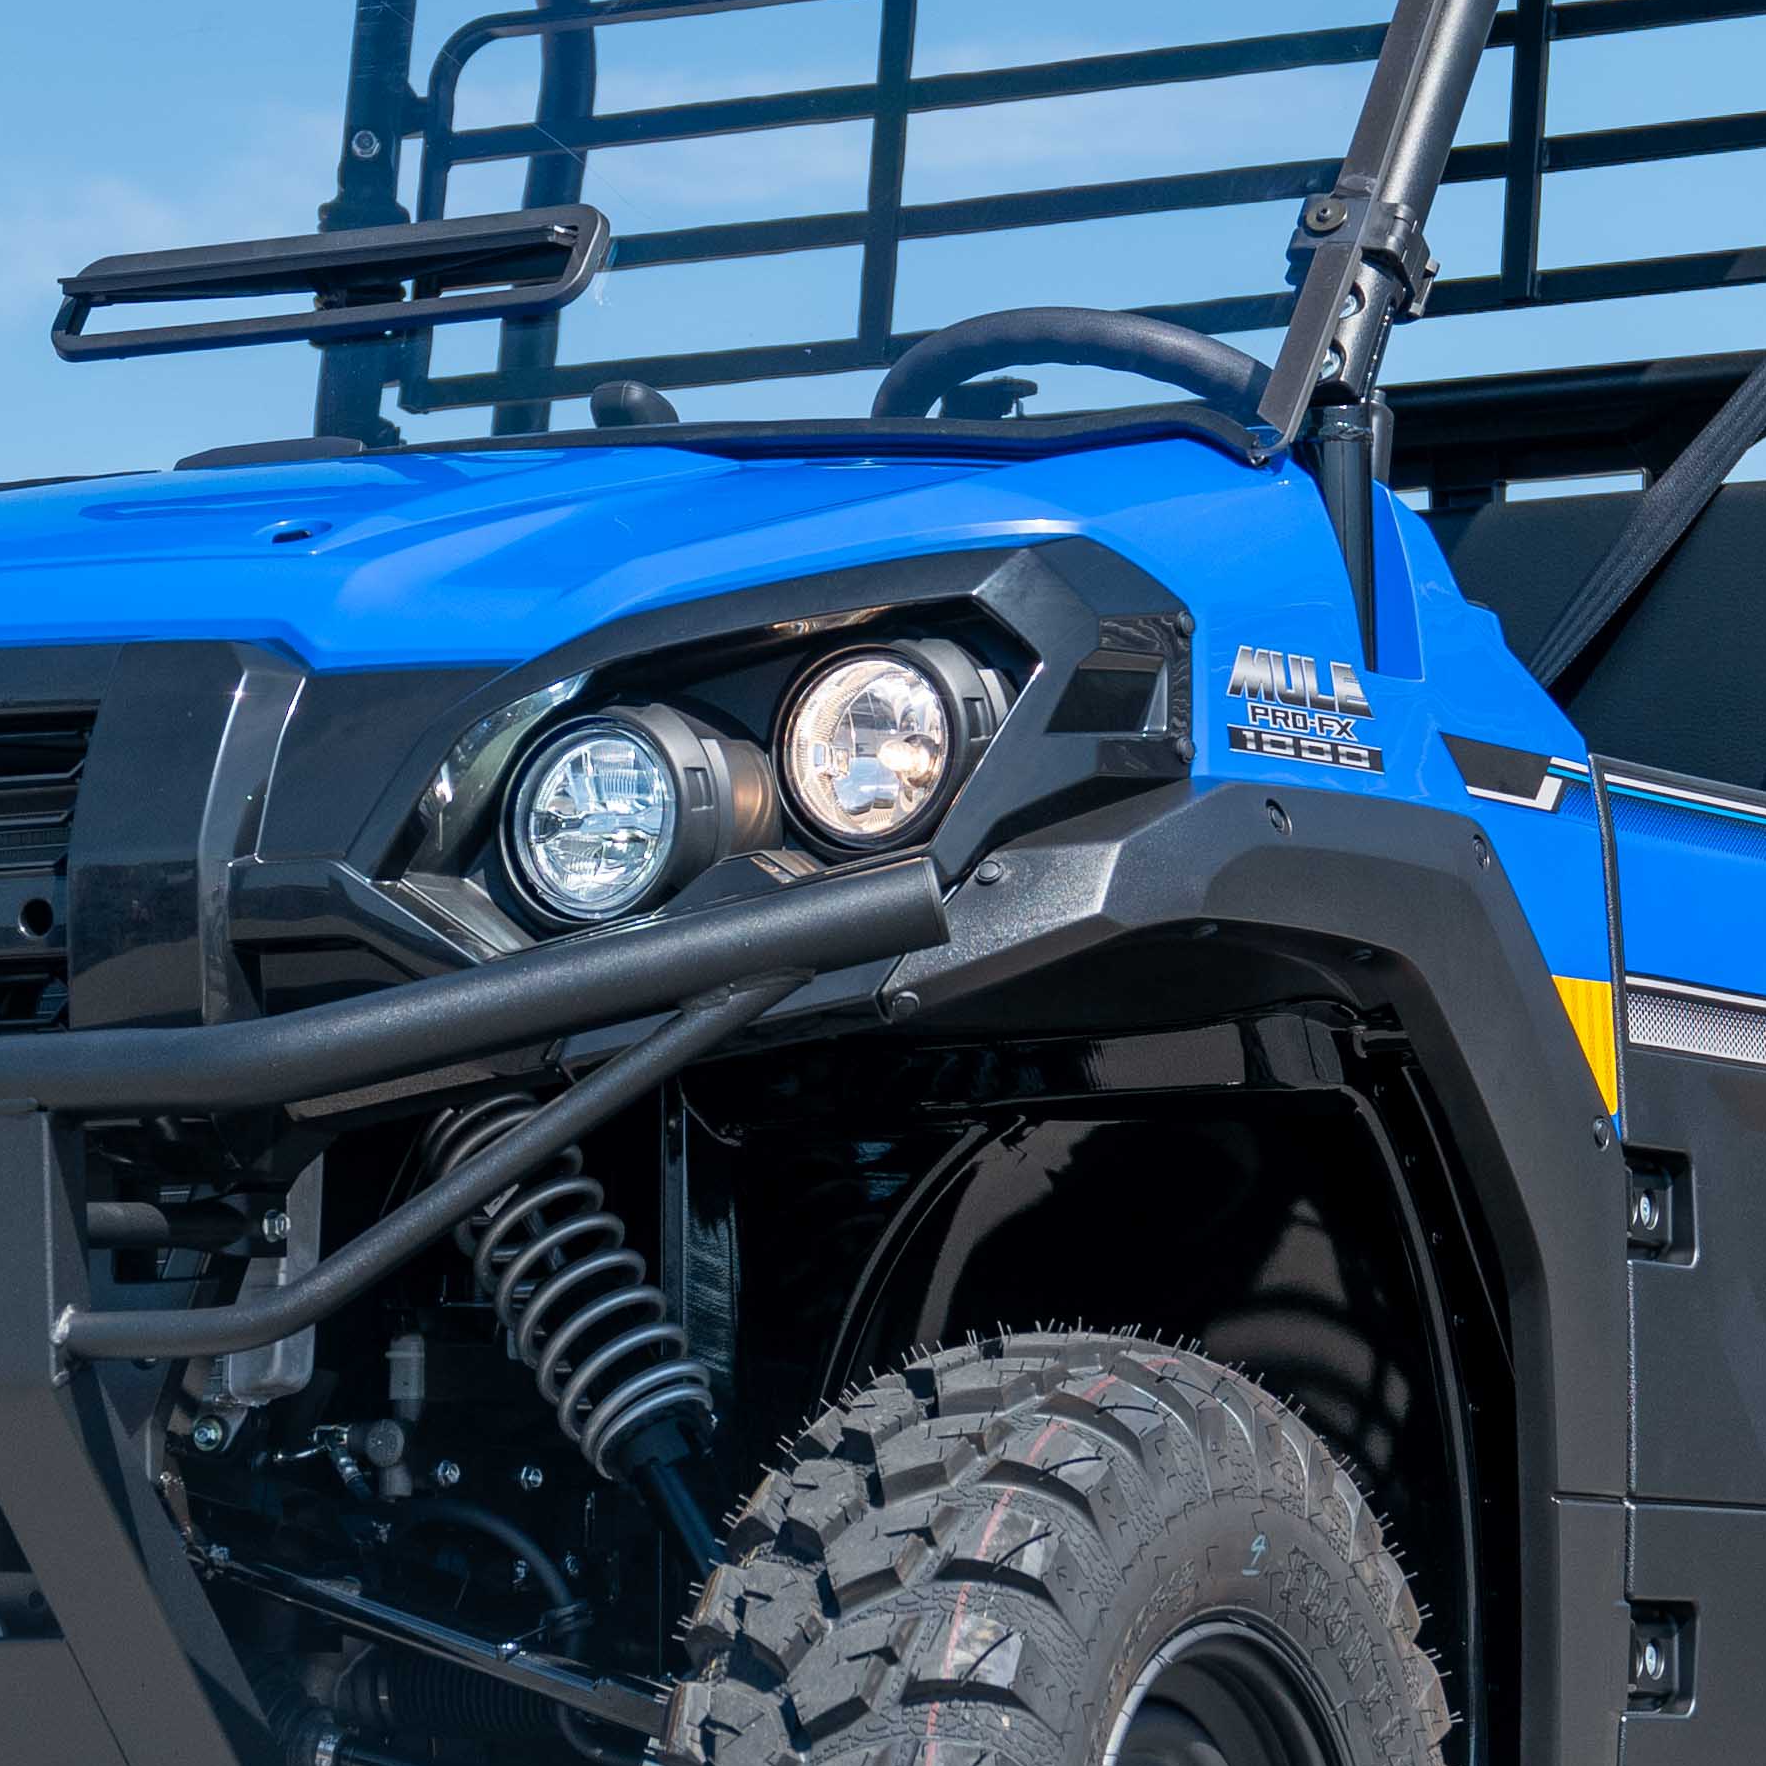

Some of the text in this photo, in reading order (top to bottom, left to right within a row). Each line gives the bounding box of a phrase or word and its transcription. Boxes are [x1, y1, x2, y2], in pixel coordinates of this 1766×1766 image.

[1226, 645, 1375, 721] MULE
[1247, 702, 1358, 741] PRO-FX
[1242, 730, 1371, 769] 1000
